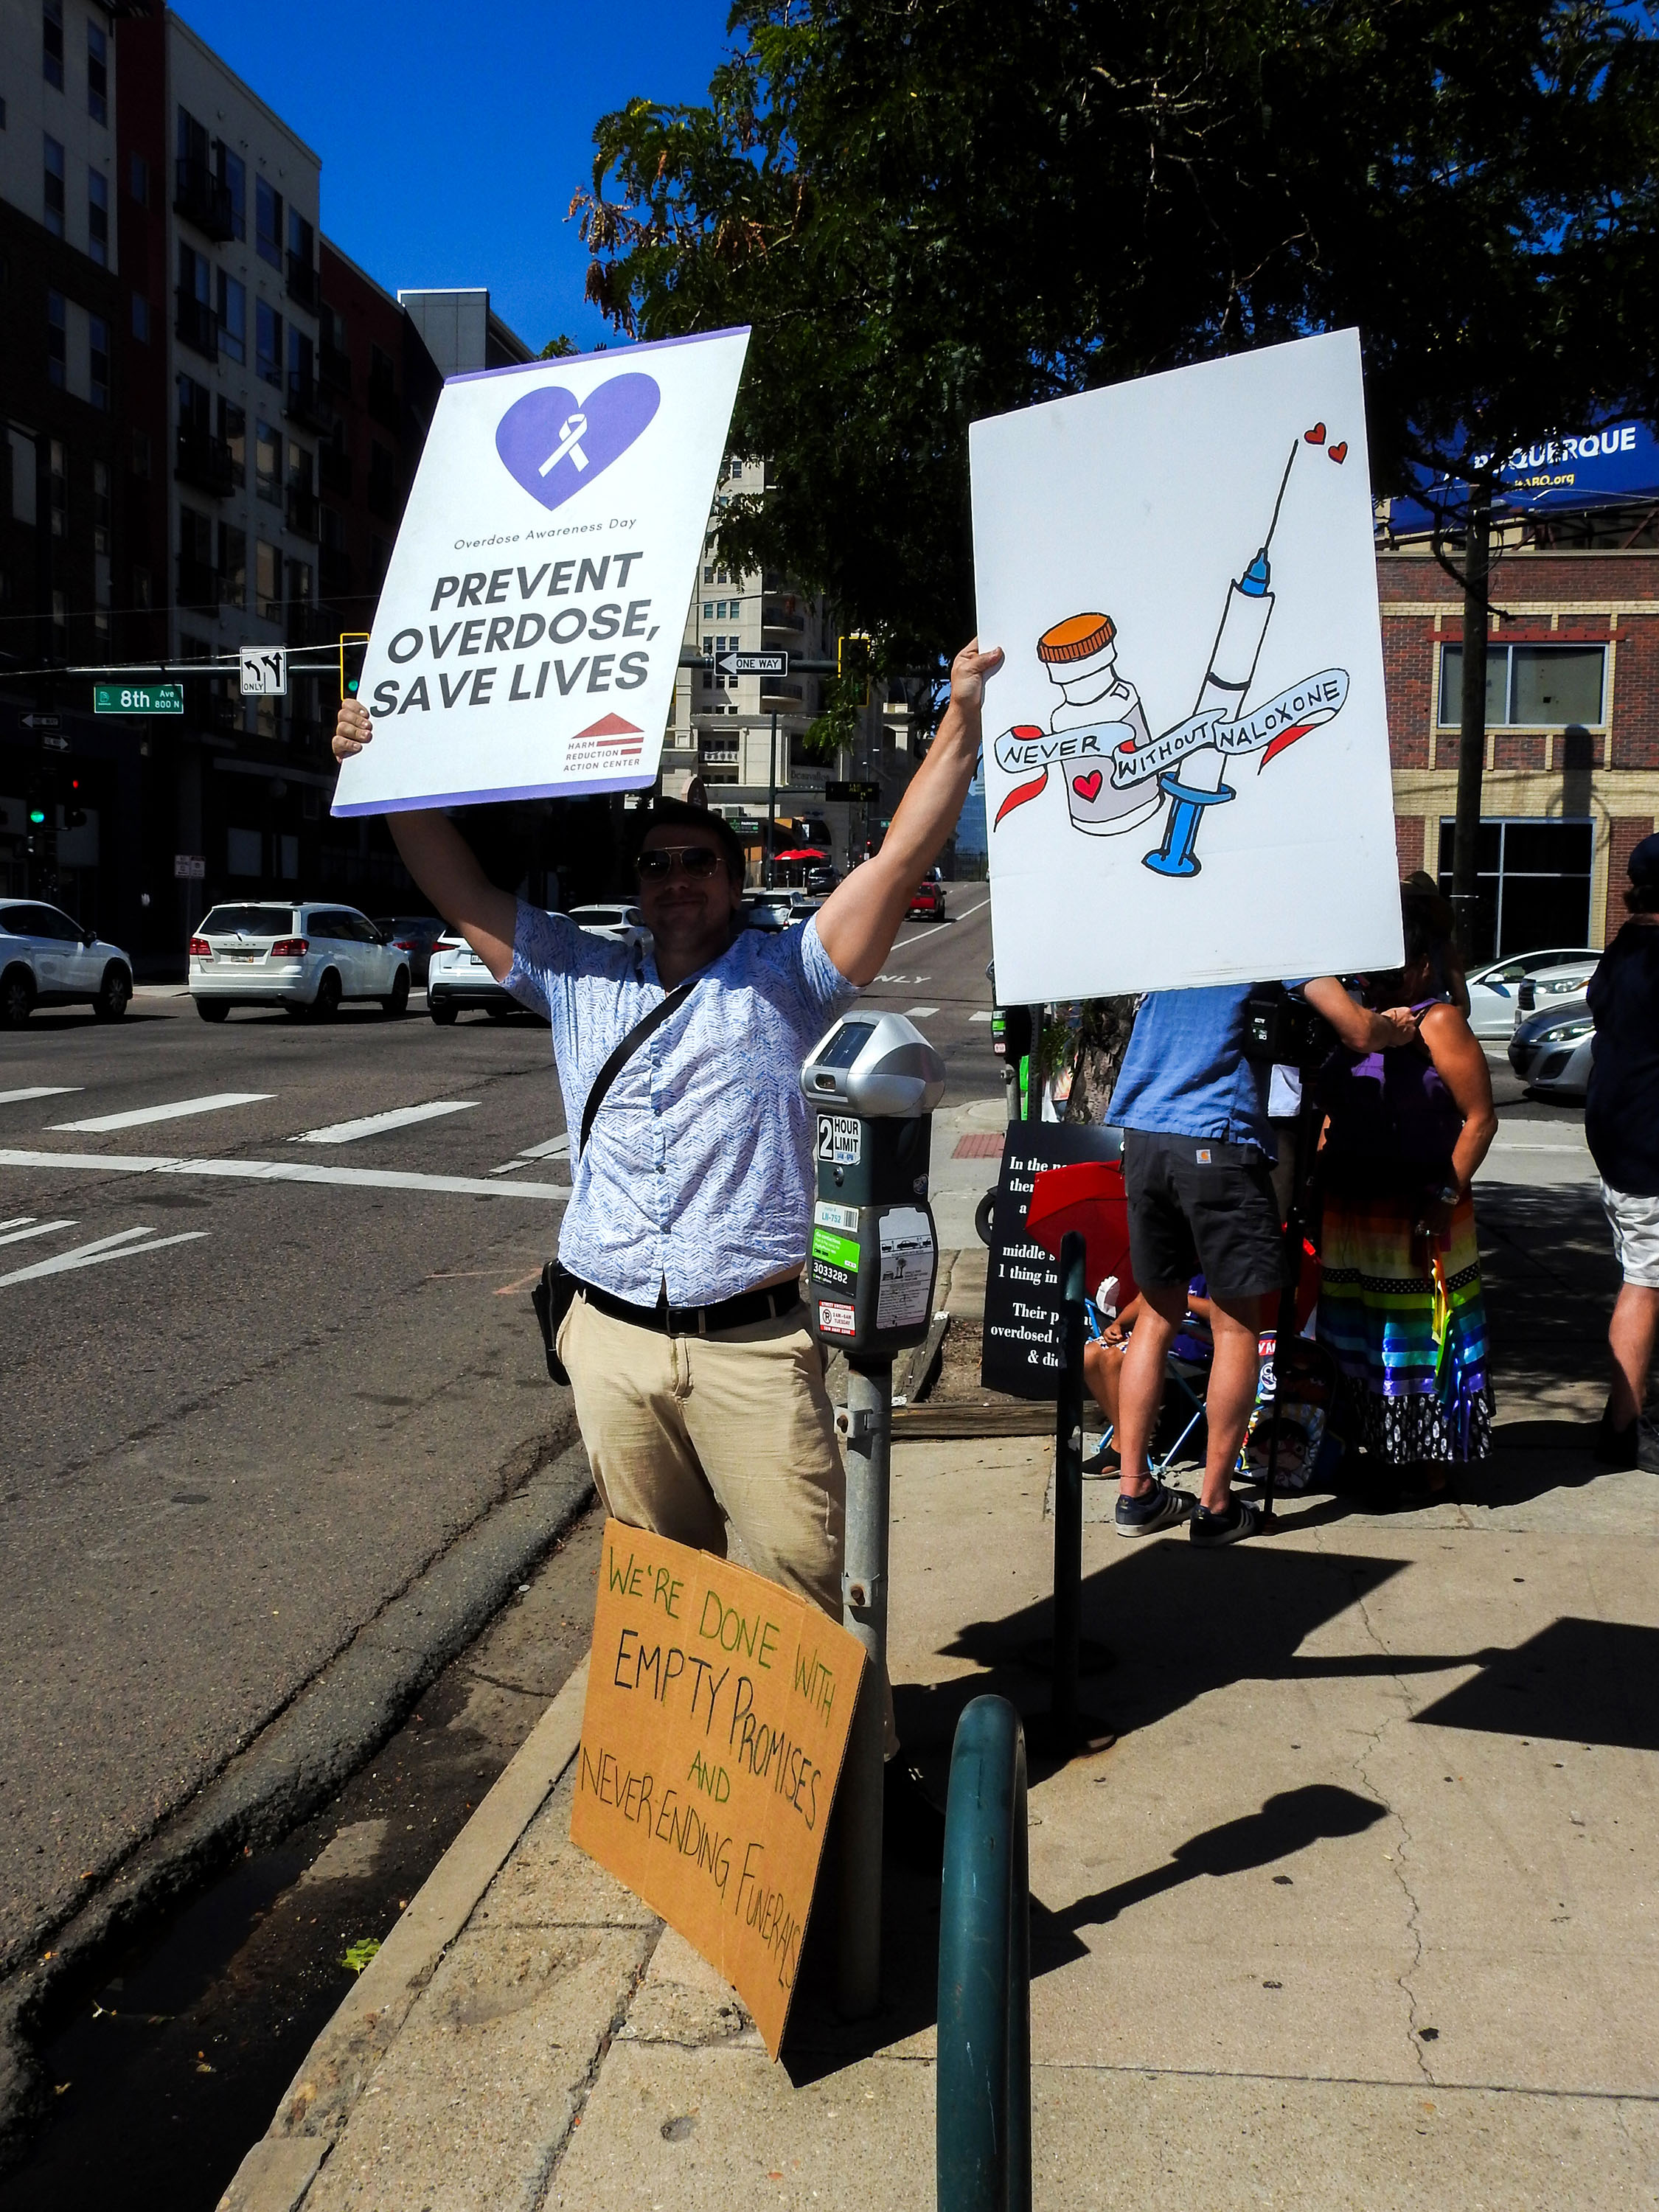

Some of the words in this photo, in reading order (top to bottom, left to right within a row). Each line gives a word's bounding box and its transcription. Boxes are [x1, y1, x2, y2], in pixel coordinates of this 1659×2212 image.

[454, 532, 520, 550] Overdose
[526, 522, 603, 541] Awareness
[609, 517, 638, 533] Day
[430, 552, 644, 611] PREVENT
[388, 599, 661, 664] OVERDOSE,
[737, 659, 756, 668] ONE
[759, 659, 779, 668] WAY
[370, 667, 496, 717] SAVE
[509, 651, 649, 702] LIVES
[120, 690, 150, 707] 8th
[1004, 737, 1101, 765] NEVER
[1117, 722, 1210, 779] WITHOUT
[1219, 680, 1342, 748] NALOXONE
[568, 740, 595, 750] HARM
[566, 749, 619, 761] REDUCTION
[563, 762, 600, 772] ACTION
[603, 759, 640, 770] CENTER
[873, 975, 932, 984] NLY
[820, 1119, 832, 1158] 2
[835, 1119, 858, 1135] HOUR
[835, 1136, 858, 1152] LIMIT
[1009, 1156, 1023, 1170] In
[1027, 1158, 1048, 1172] the
[1019, 1205, 1027, 1214] a
[1002, 1244, 1046, 1261] middle
[813, 1262, 848, 1284] 3033282
[1009, 1265, 1042, 1285] thing
[1045, 1270, 1058, 1284] in
[1012, 1302, 1047, 1320] Their
[990, 1326, 1053, 1343] overdosed
[1027, 1349, 1039, 1364] &
[609, 1546, 685, 1621] WE'RE
[701, 1590, 781, 1670] DONE
[794, 1644, 837, 1728] WITH
[614, 1629, 730, 1736] EMPTY
[729, 1676, 821, 1832] PROMISES
[687, 1750, 731, 1803] AND
[735, 1842, 801, 1992] FUNERALS
